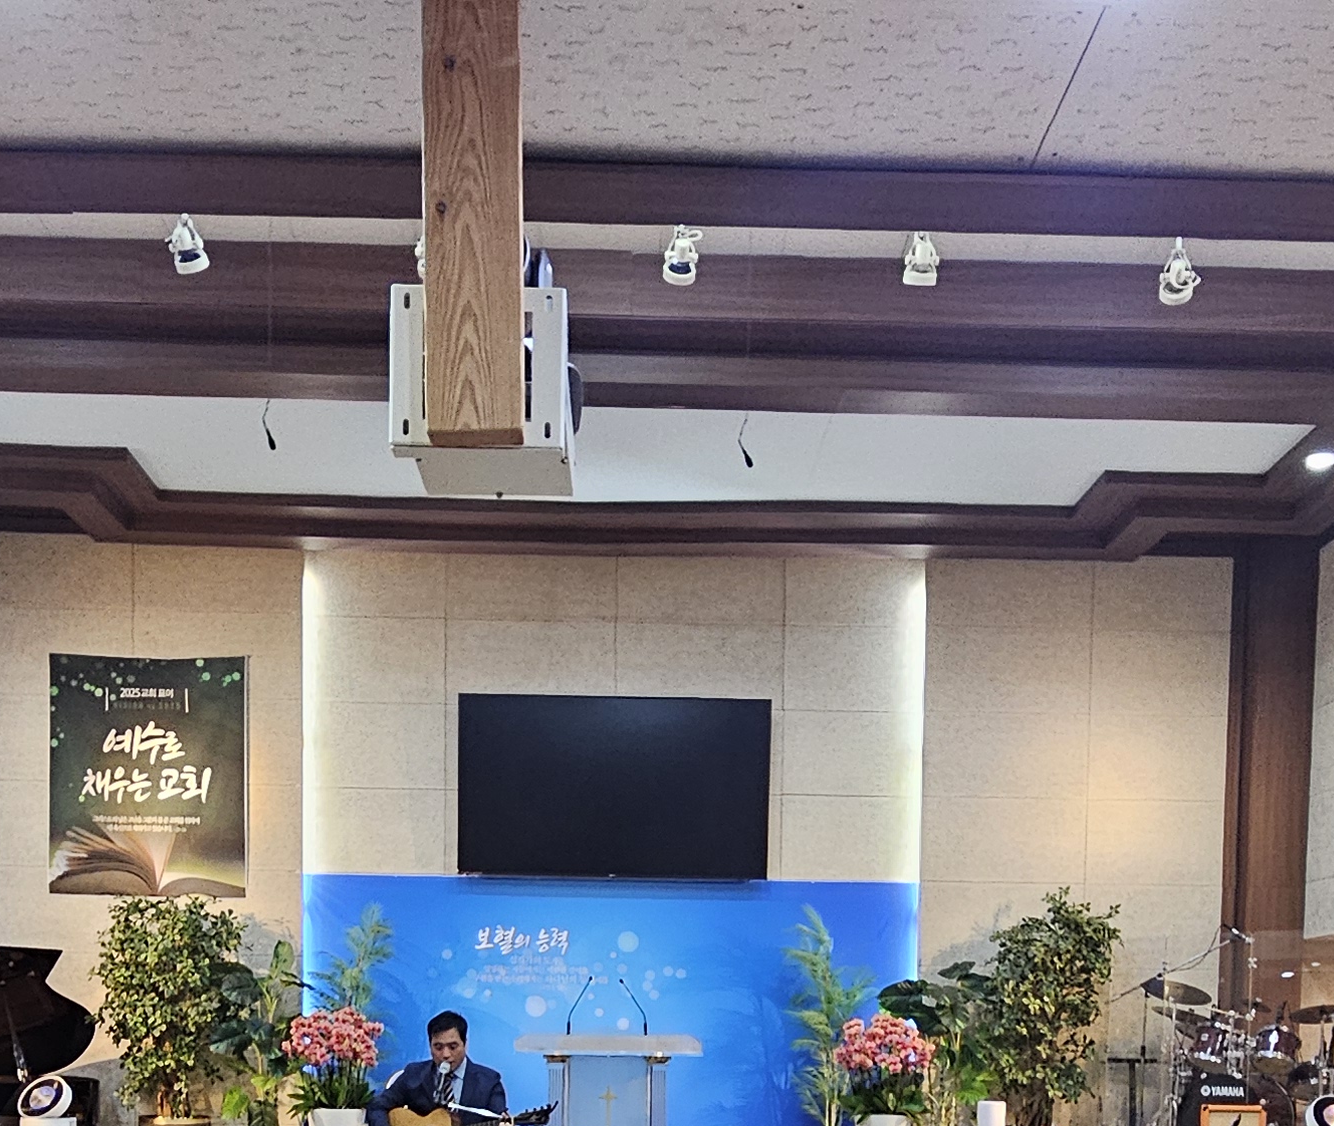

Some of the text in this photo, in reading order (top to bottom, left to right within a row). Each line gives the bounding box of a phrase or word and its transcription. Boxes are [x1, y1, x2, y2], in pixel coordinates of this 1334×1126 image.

[120, 687, 141, 698] 2025
[103, 720, 185, 765] 예수로
[82, 765, 212, 803] 채우는 교회
[475, 924, 570, 955] 보혈의 능력
[1211, 1086, 1244, 1097] YAMAHA
